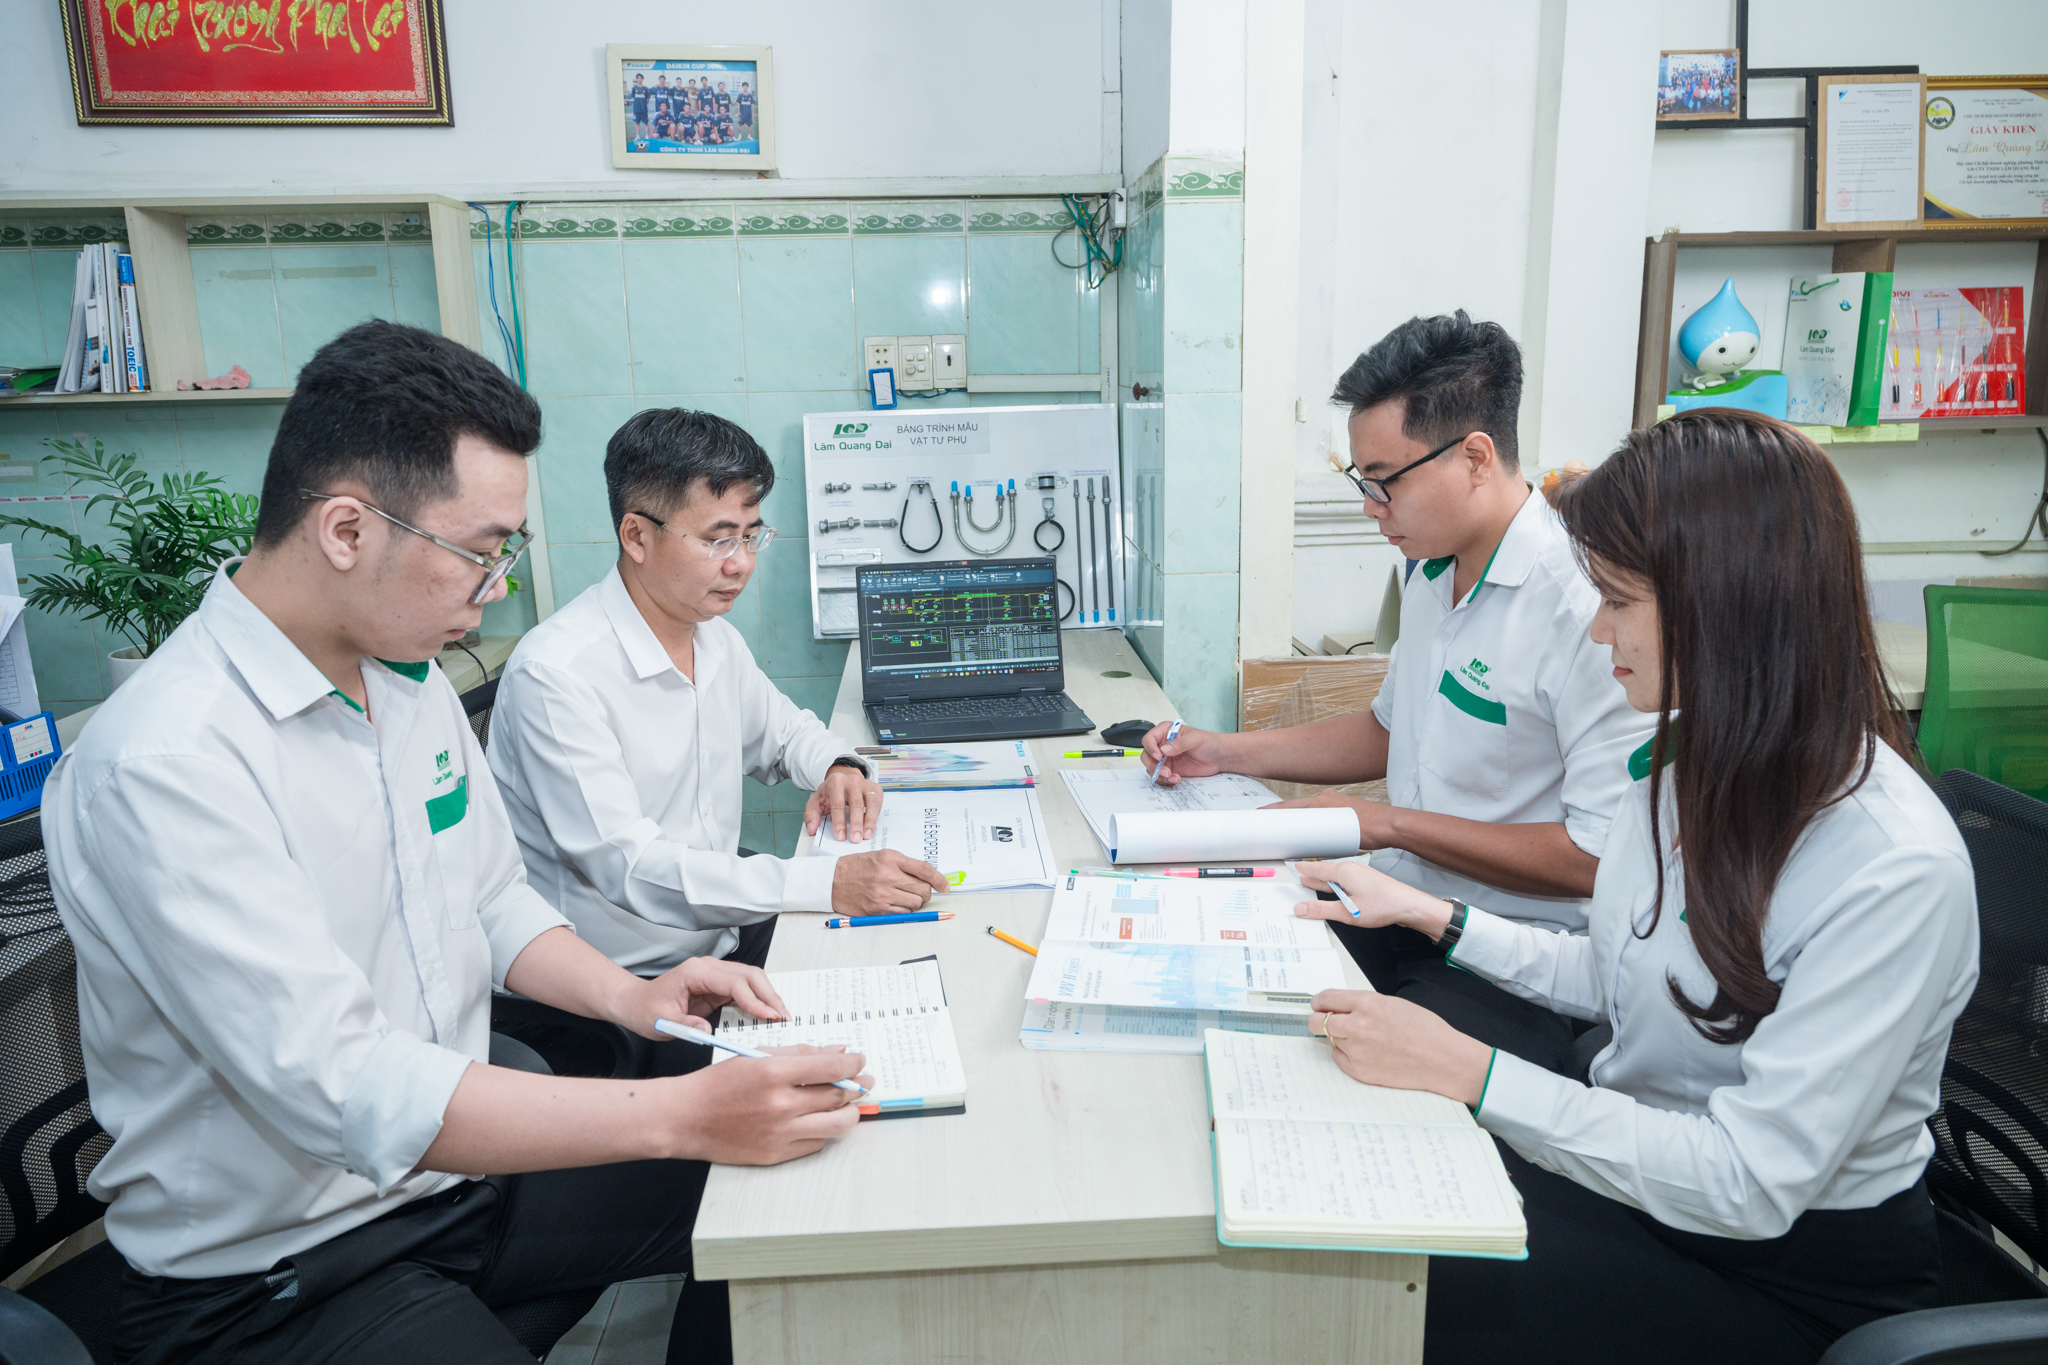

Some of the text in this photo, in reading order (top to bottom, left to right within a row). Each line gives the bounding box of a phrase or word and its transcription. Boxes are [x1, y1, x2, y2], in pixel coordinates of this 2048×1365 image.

[2003, 125, 2036, 134] KHEN
[1947, 144, 1958, 153] Ông
[1958, 141, 1989, 153] Lâm
[1993, 140, 2032, 156] Quang
[127, 346, 136, 372] TOEIC
[897, 422, 978, 434] BẢNG TRÌNH MẪU
[814, 440, 892, 451] Lâm Quang Đại
[910, 436, 967, 447] VẬT TƯ PHỤ
[1468, 672, 1481, 686] Quang
[1481, 681, 1490, 690] Đại
[1015, 744, 1026, 757] DAIKIN
[924, 808, 941, 819] BẢN
[924, 820, 941, 829] VẼ
[1058, 980, 1075, 997] VRV
[1068, 957, 1080, 974] SERIES
[1064, 1011, 1072, 1020] VRV
[1043, 1017, 1056, 1029] Dàn
